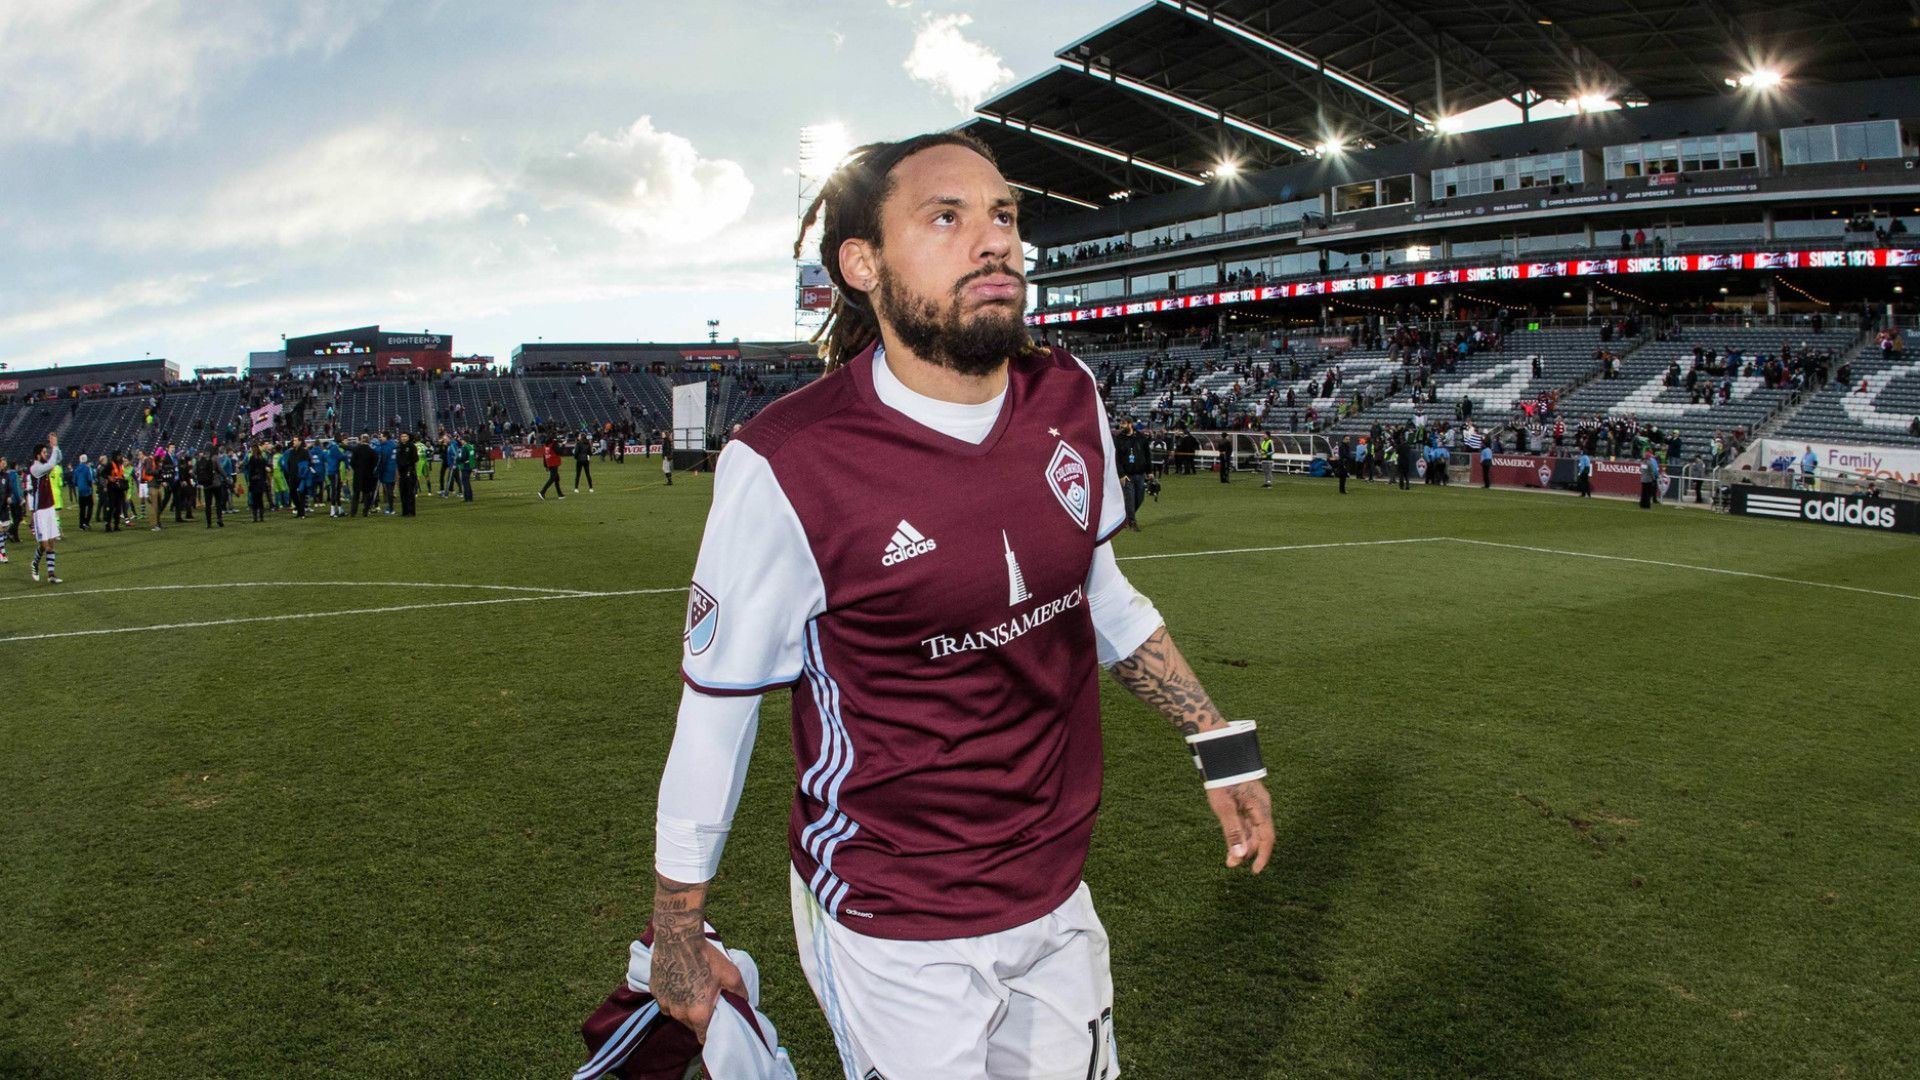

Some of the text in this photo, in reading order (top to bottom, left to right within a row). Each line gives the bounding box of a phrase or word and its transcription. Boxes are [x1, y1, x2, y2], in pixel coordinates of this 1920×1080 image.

[1627, 257, 1661, 273] SINCE
[1662, 256, 1687, 272] 1876
[1809, 251, 1846, 267] SINCE
[1847, 250, 1875, 267] 1876
[1467, 267, 1496, 281] SINCE
[1497, 265, 1519, 279] 1876
[388, 336, 430, 345] EIGHTEEN
[1597, 461, 1641, 474] TRANSAMER
[1828, 449, 1882, 472] Family
[1055, 462, 1083, 482] COLORADO
[1804, 497, 1896, 528] adidas
[881, 538, 937, 567] adidas
[921, 584, 1083, 660] TRANSAMERICA
